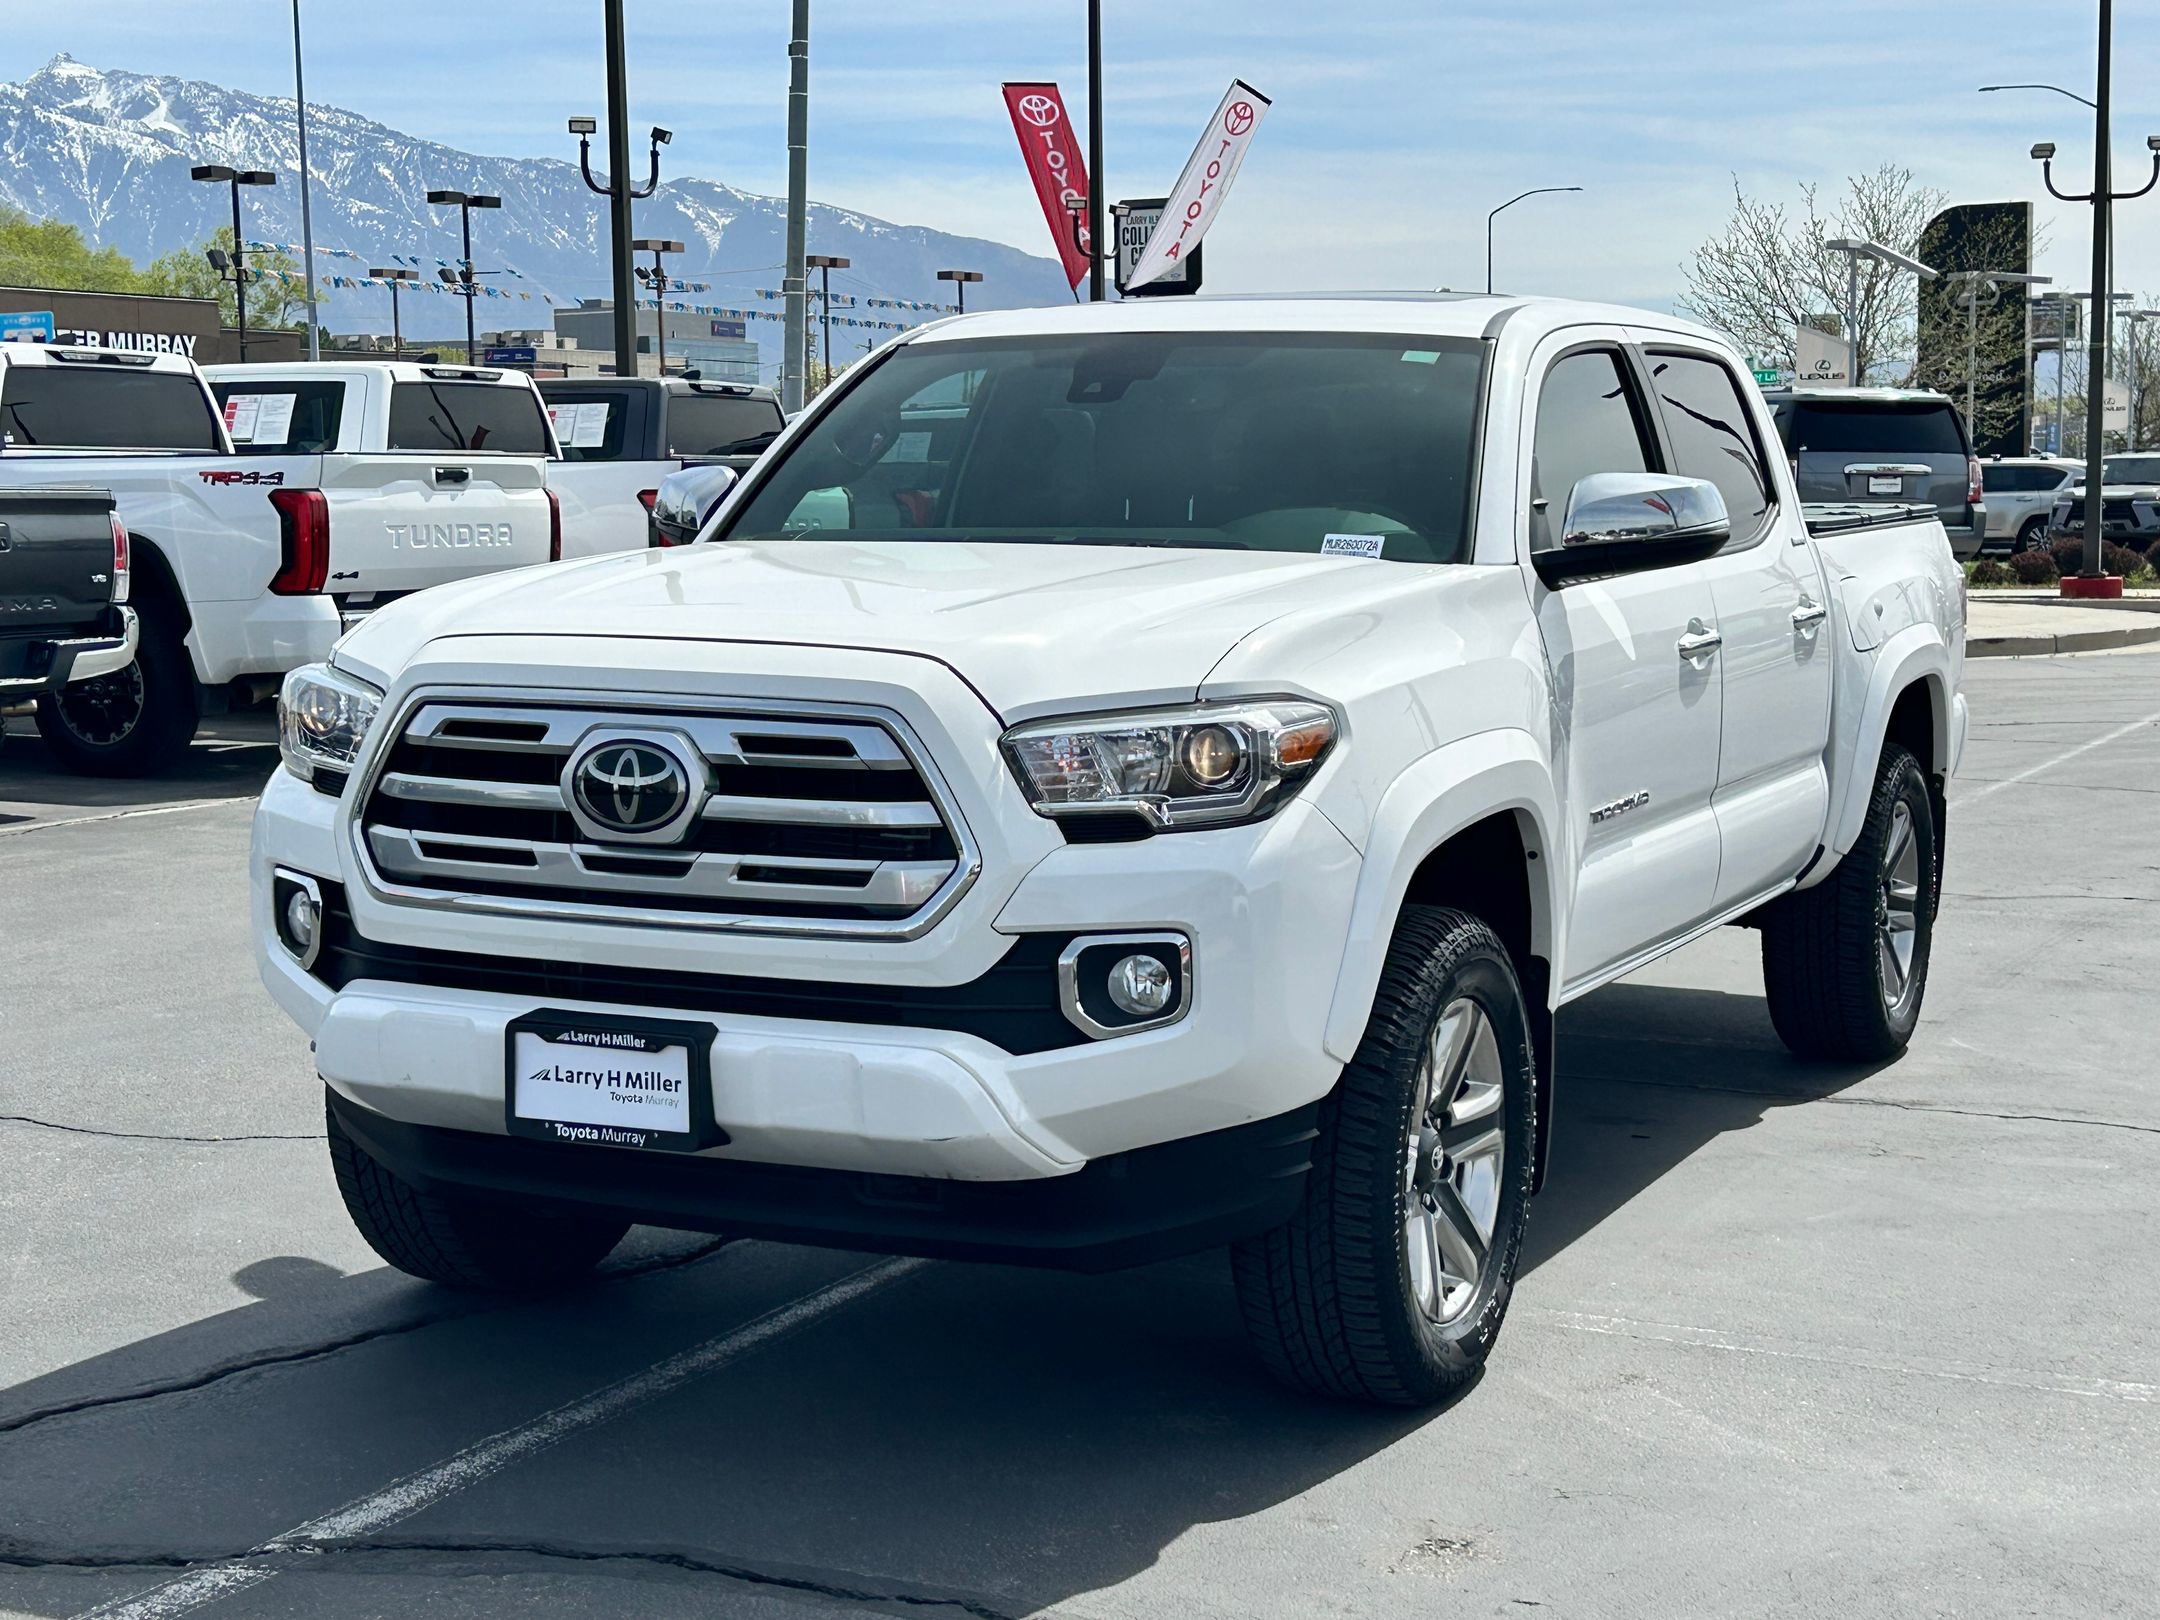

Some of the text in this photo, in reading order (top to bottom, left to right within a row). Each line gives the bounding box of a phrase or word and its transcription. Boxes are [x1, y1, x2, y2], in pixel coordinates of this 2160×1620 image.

[1164, 140, 1231, 261] TOYOTA
[108, 331, 197, 357] MURRAY
[1799, 373, 1846, 381] LEXUS
[199, 471, 243, 486] TRD
[385, 523, 513, 549] TUNDRA
[1589, 790, 1649, 824] TACOMA
[570, 1030, 646, 1048] Larry H Miller
[555, 1065, 682, 1093] Larry H Miller
[610, 1092, 679, 1108] Toyota Murray
[555, 1123, 647, 1147] Toyota Murray
